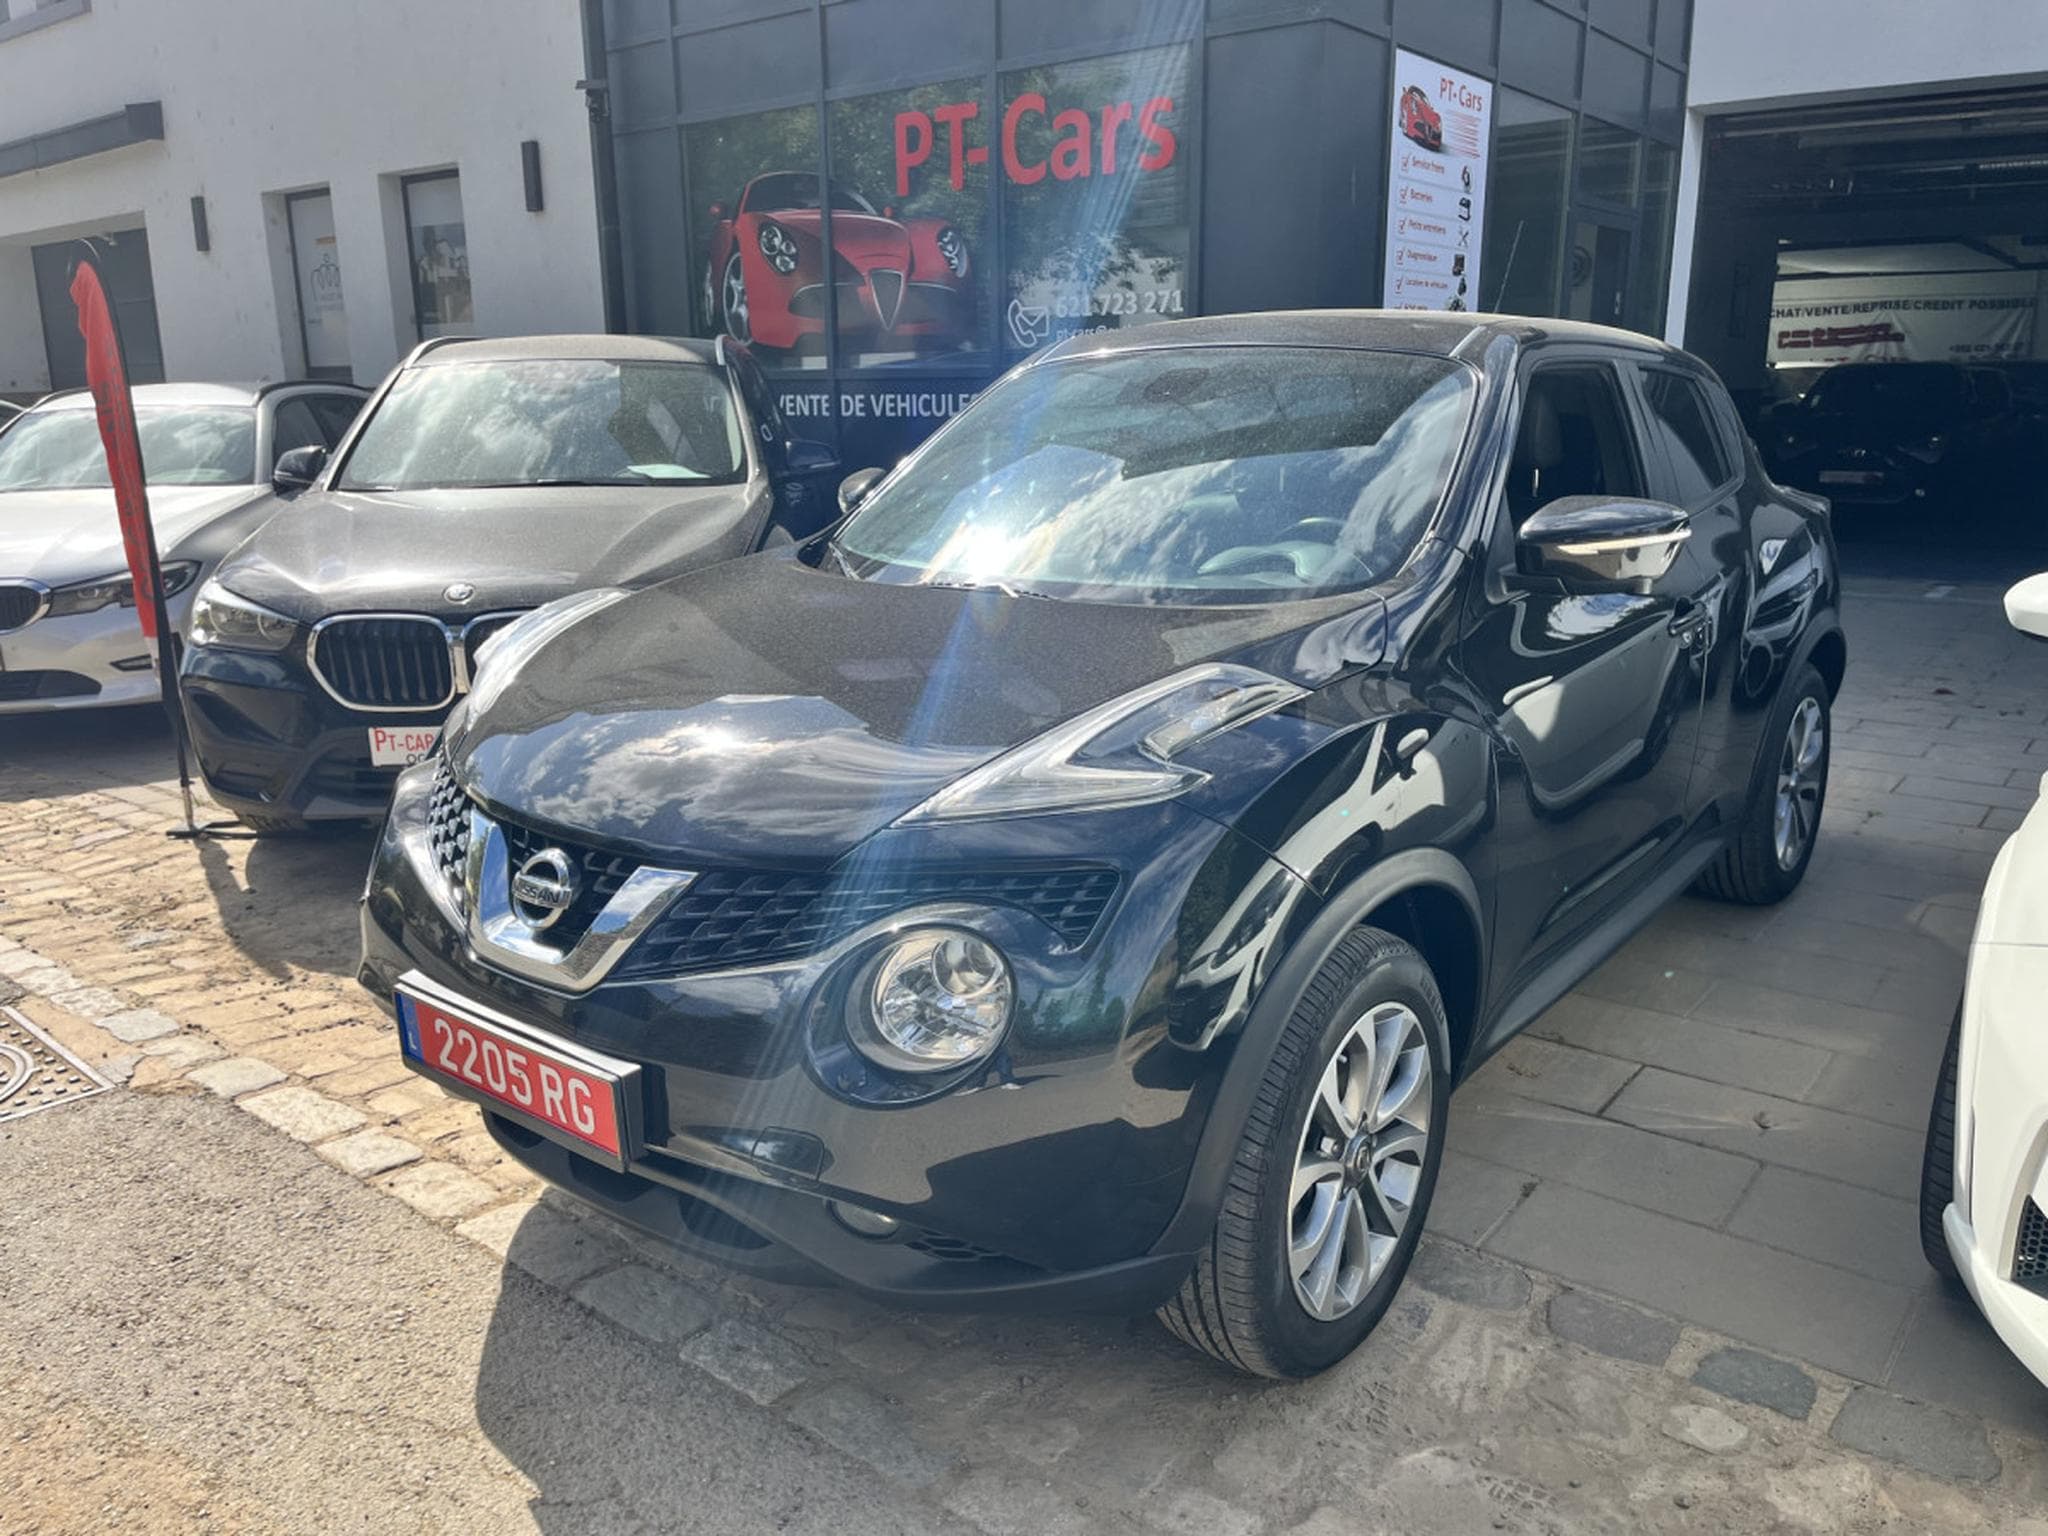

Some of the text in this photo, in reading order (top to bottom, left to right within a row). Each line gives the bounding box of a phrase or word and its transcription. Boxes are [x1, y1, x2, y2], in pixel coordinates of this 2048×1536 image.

[1439, 76, 1483, 113] PT-Cars
[894, 91, 1178, 197] PT-Cars
[1056, 289, 1184, 318] 621 723 271
[840, 393, 865, 417] DE
[513, 877, 561, 904] NISSAN
[407, 1031, 418, 1051] L
[434, 1018, 596, 1135] 2205 RG
